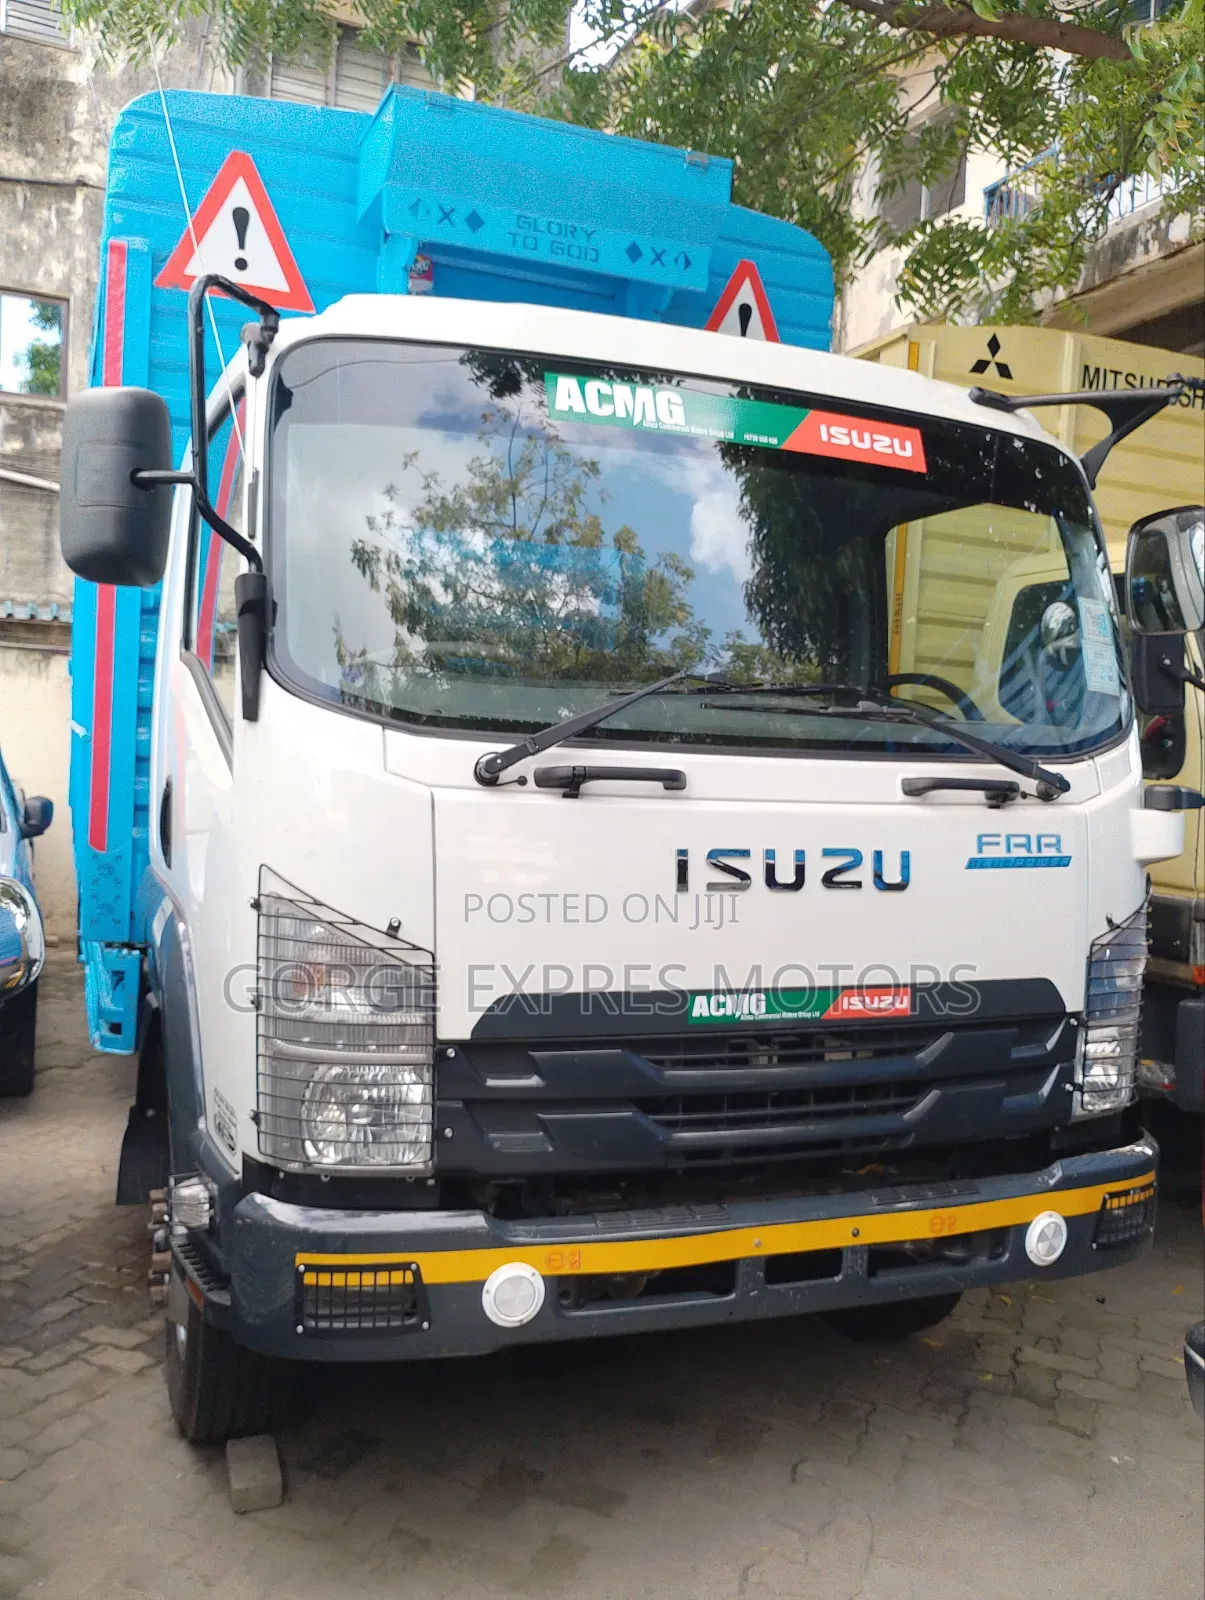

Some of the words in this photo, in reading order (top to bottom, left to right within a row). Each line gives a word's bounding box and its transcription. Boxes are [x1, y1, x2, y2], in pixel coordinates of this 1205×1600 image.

[517, 214, 597, 242] GLORY
[507, 231, 538, 251] TO
[550, 240, 599, 262] GOD
[554, 377, 686, 427] ACMG
[820, 423, 913, 458] ISUZU
[675, 847, 911, 893] ISUZU
[691, 992, 767, 1019] ACMG
[842, 995, 909, 1011] ISUZU
